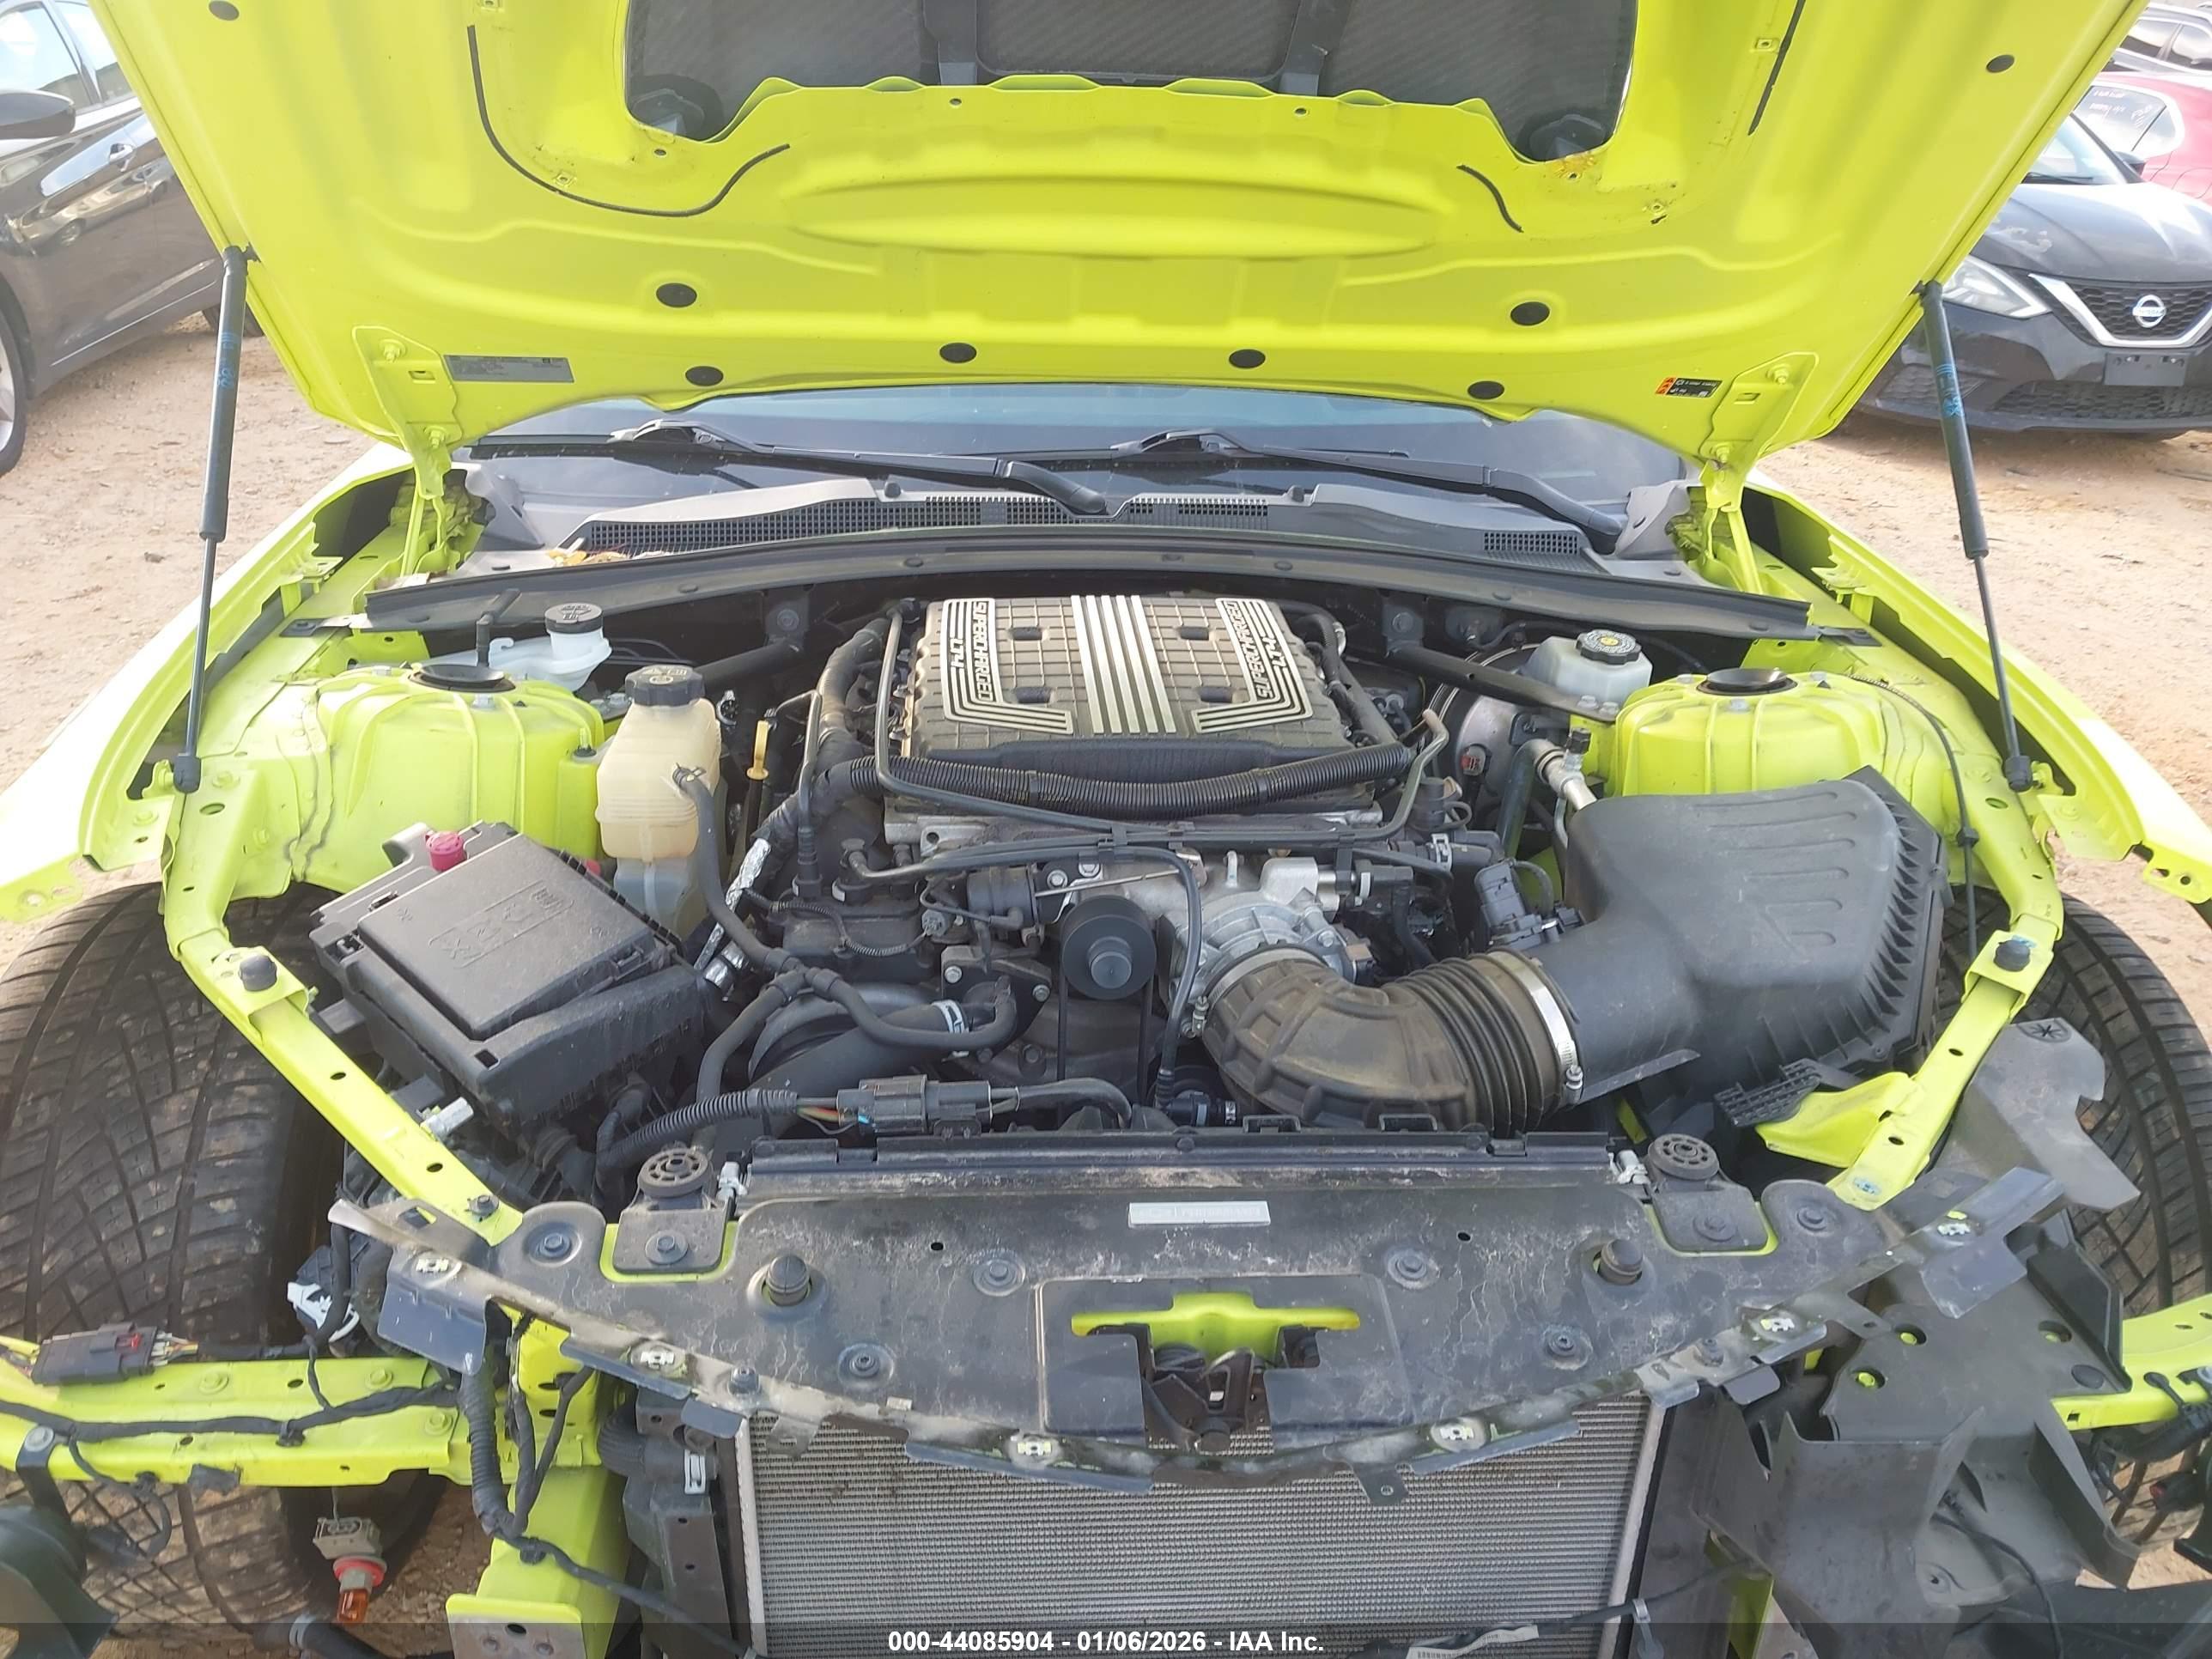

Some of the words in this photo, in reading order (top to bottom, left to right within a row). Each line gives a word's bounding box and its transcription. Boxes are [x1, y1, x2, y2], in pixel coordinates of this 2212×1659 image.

[950, 638, 964, 668] LT4
[972, 601, 994, 702] SUPERCHARGED
[1224, 601, 1273, 699] SUPERCHARGED
[1261, 636, 1286, 667] LT4
